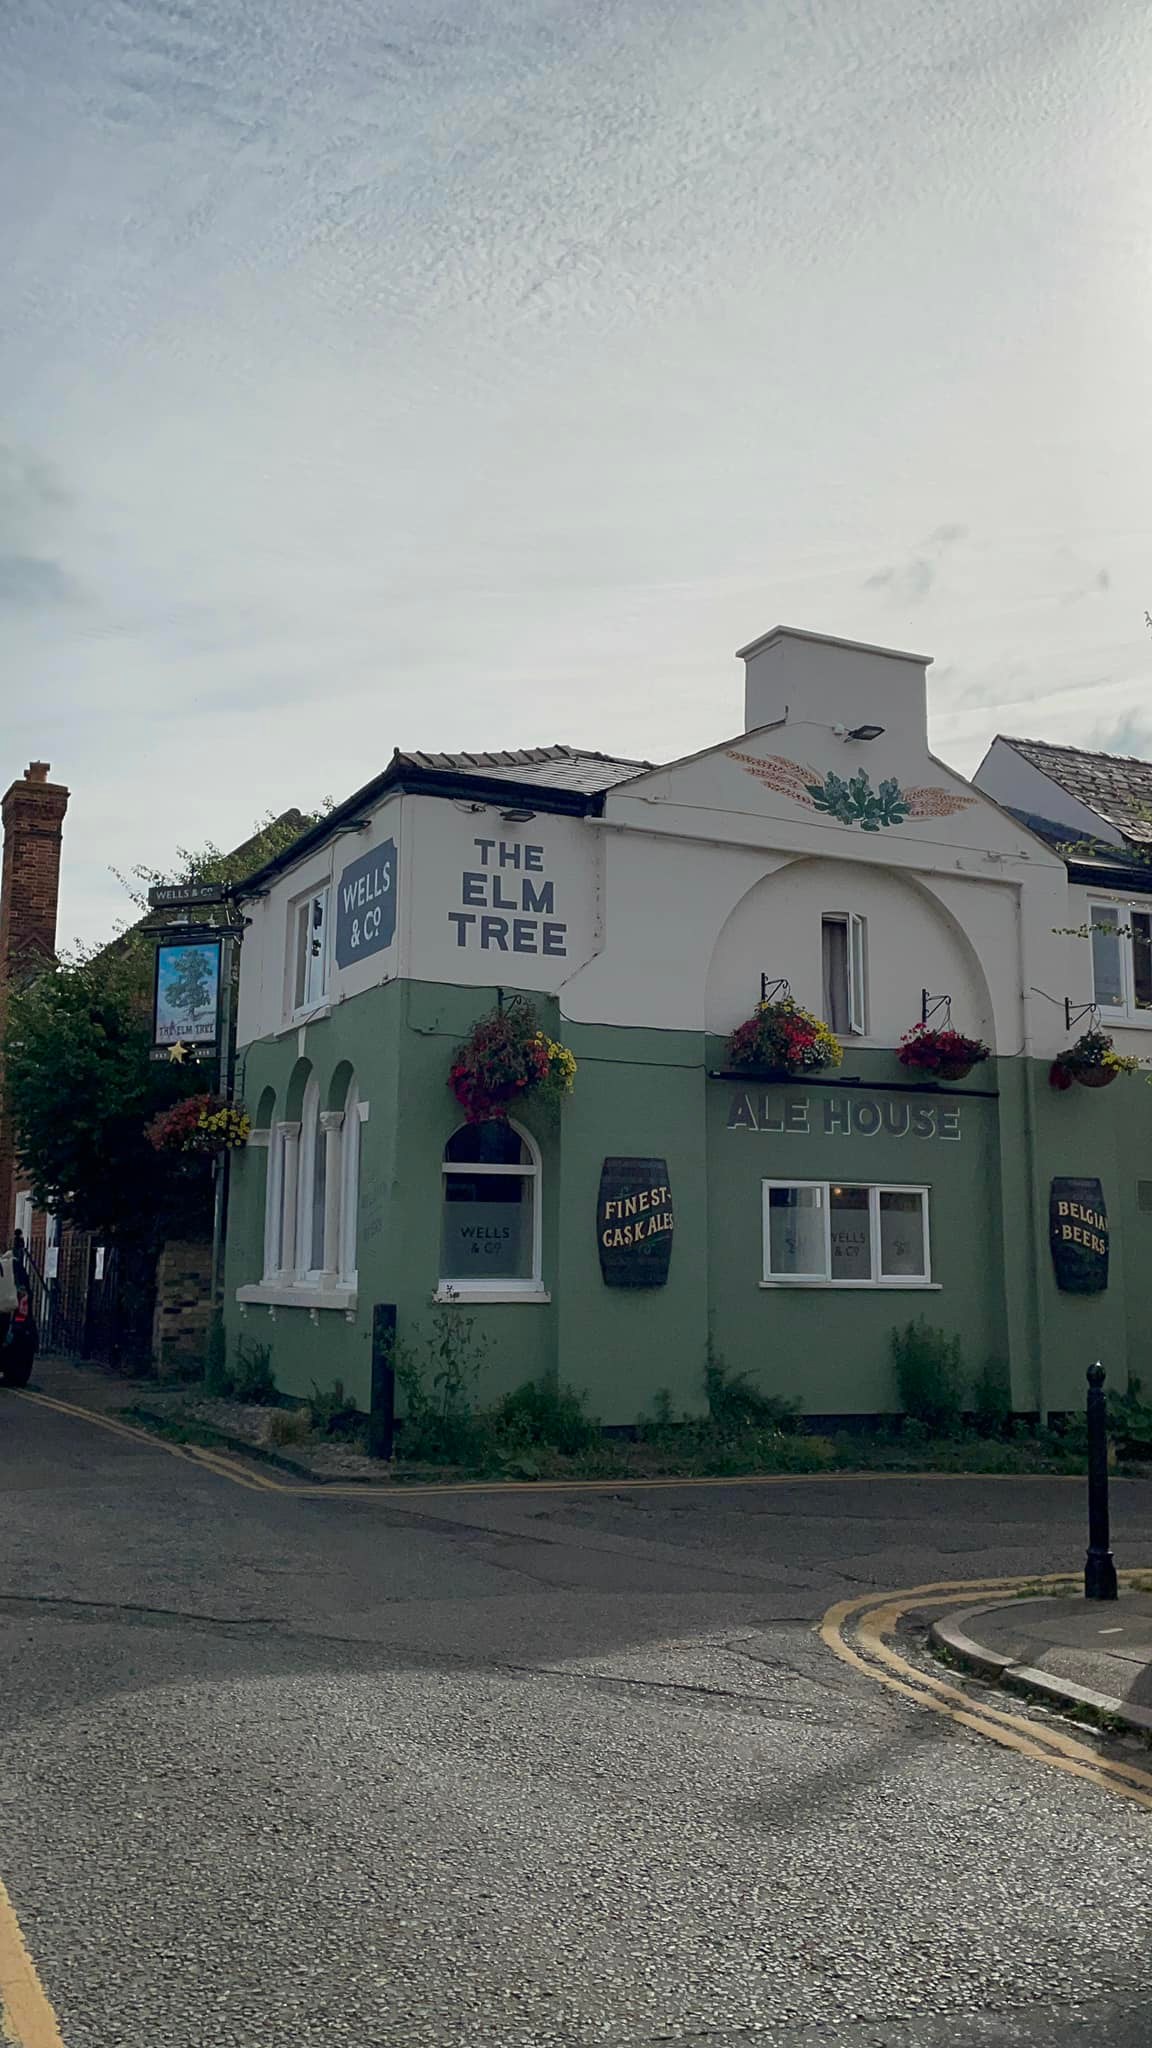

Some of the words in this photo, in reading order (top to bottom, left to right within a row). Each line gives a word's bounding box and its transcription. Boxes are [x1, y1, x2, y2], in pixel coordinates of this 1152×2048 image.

[474, 838, 544, 872] THE
[156, 889, 190, 899] WELLS
[343, 861, 390, 914] WELLS
[462, 871, 554, 914] ELM
[351, 919, 361, 948] &
[448, 912, 567, 956] TREE
[727, 1092, 810, 1134] ALE
[823, 1098, 961, 1141] HOUSE
[605, 1187, 667, 1219] FINEST
[460, 1226, 510, 1239] WELLS
[602, 1221, 645, 1247] CASK
[647, 1213, 674, 1235] ALES
[1061, 1224, 1105, 1255] BEERS
